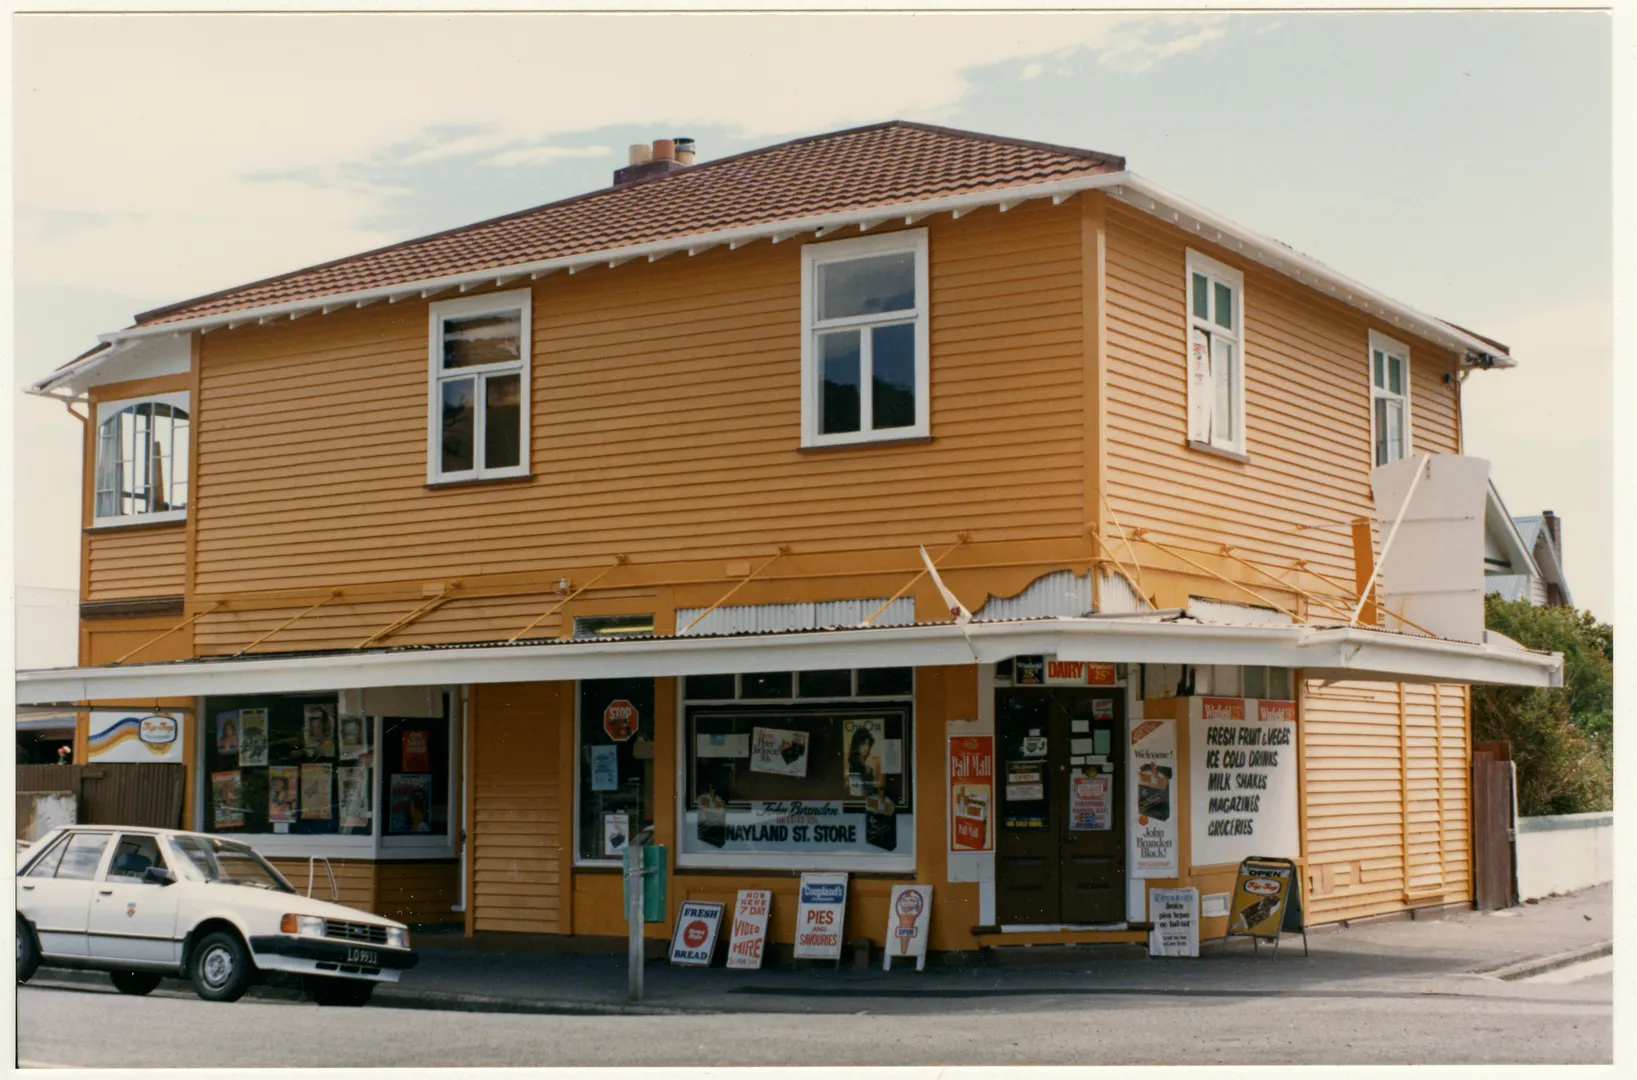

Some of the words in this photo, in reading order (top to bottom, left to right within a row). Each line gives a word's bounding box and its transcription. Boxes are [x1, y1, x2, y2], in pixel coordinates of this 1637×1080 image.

[1047, 661, 1084, 679] DAIRY
[609, 707, 632, 720] STOP
[1205, 704, 1232, 720] Winfield
[1260, 707, 1284, 721] Winfield
[1207, 726, 1236, 746] FRESH
[1238, 727, 1262, 746] FRUIT
[1267, 727, 1291, 746] VEGES
[952, 756, 970, 776] Pall
[972, 756, 991, 776] Mall
[1206, 750, 1220, 769] ICE
[1223, 750, 1246, 769] COLD
[1248, 750, 1279, 768] DRINKS
[1208, 772, 1231, 791] MILK
[1236, 773, 1268, 790] SHAKES
[756, 802, 788, 816] John
[790, 802, 840, 816] Brandon
[1208, 794, 1260, 814] MAGAZINES
[726, 825, 788, 842] NAYLAND
[793, 826, 810, 842] ST.
[814, 826, 856, 842] STORE
[1143, 827, 1164, 838] John
[1208, 819, 1253, 836] GROCERIES
[1136, 837, 1173, 849] Brandon
[1249, 869, 1281, 877] OPEN
[683, 908, 719, 918] FRESH
[740, 907, 748, 915] 7
[749, 906, 767, 916] DAY
[807, 910, 834, 924] PIES
[734, 918, 760, 937] VIDEO
[799, 934, 837, 946] SAVOURIES
[674, 949, 708, 960] BREAD
[733, 938, 763, 958] HIRE
